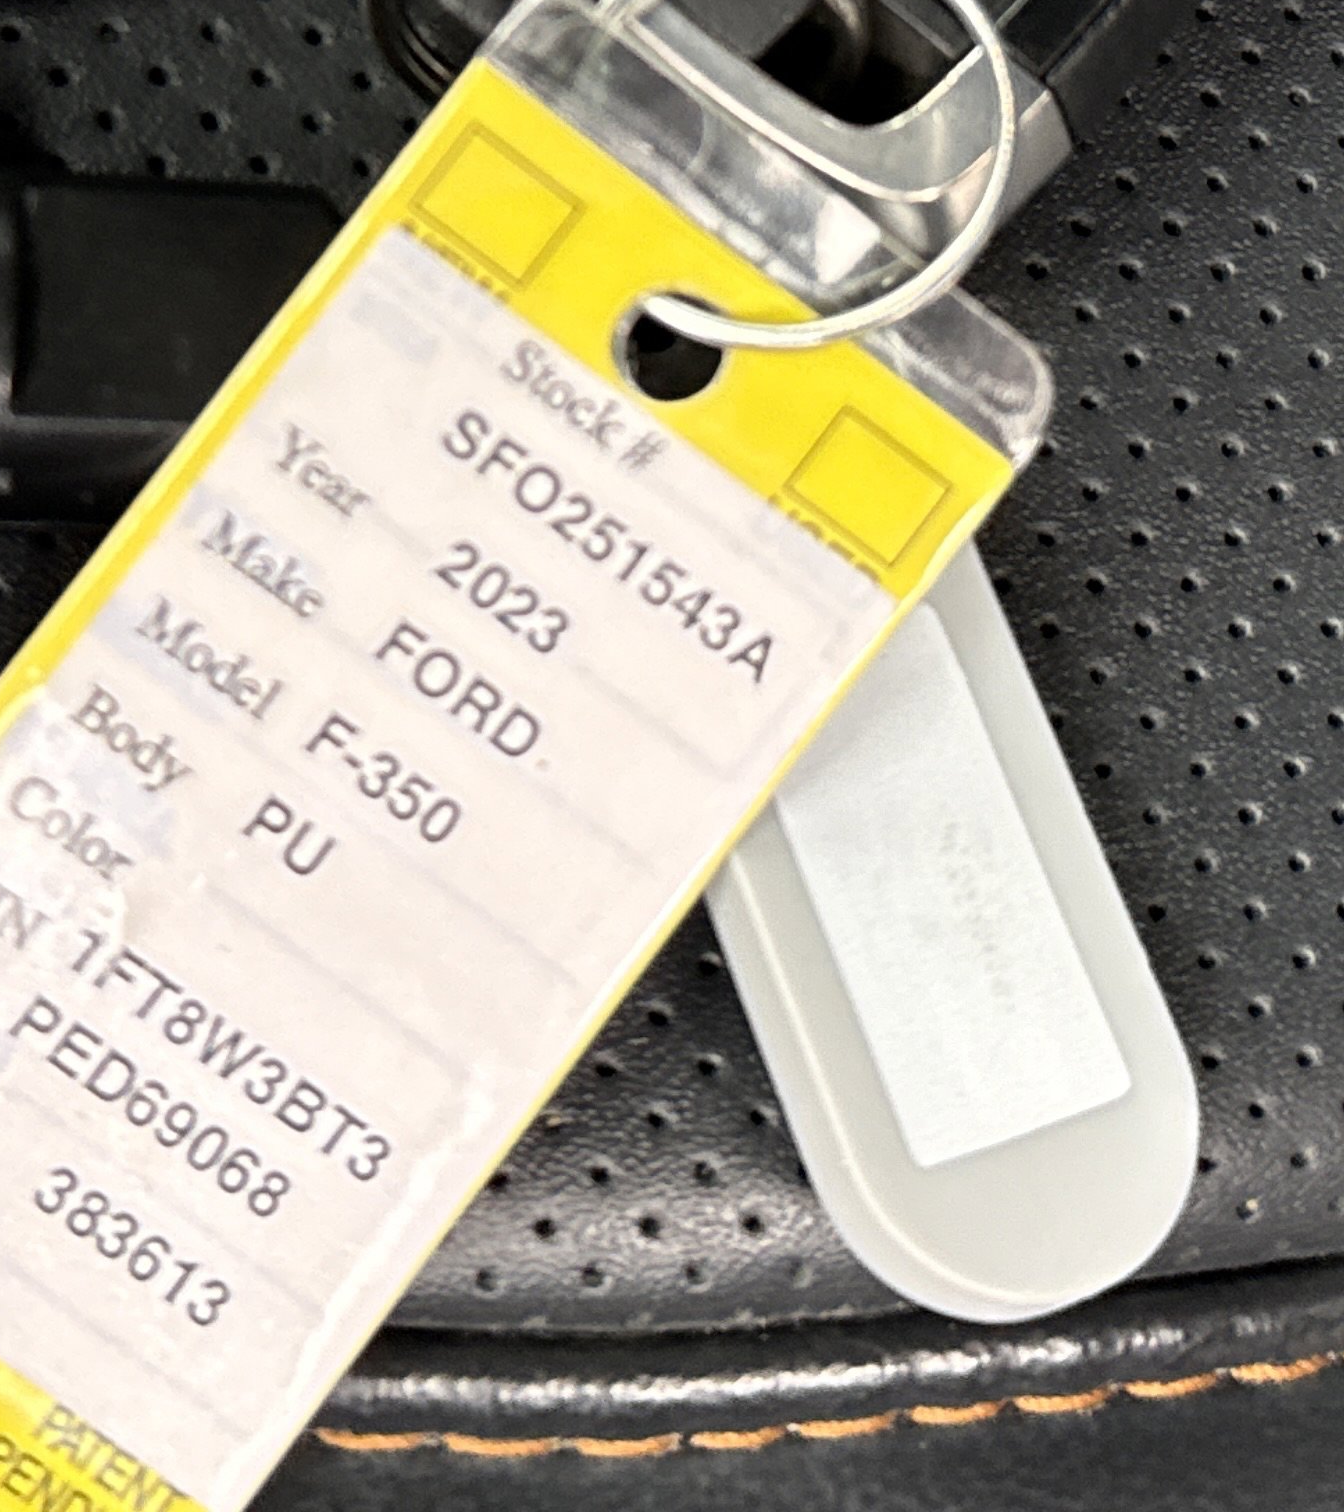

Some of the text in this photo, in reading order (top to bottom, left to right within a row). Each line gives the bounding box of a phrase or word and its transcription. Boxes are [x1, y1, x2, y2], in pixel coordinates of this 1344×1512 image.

[501, 339, 662, 475] Stock #
[201, 508, 543, 761] Make FORD
[274, 422, 570, 656] Year 2023
[441, 410, 776, 686] SFO251543A
[8, 774, 136, 882] Color
[69, 686, 337, 878] Body PU
[135, 594, 461, 845] Model F-350
[9, 995, 292, 1218] PED69068
[70, 930, 392, 1184] 1FT8W3BT3
[33, 1166, 233, 1328] 383613
